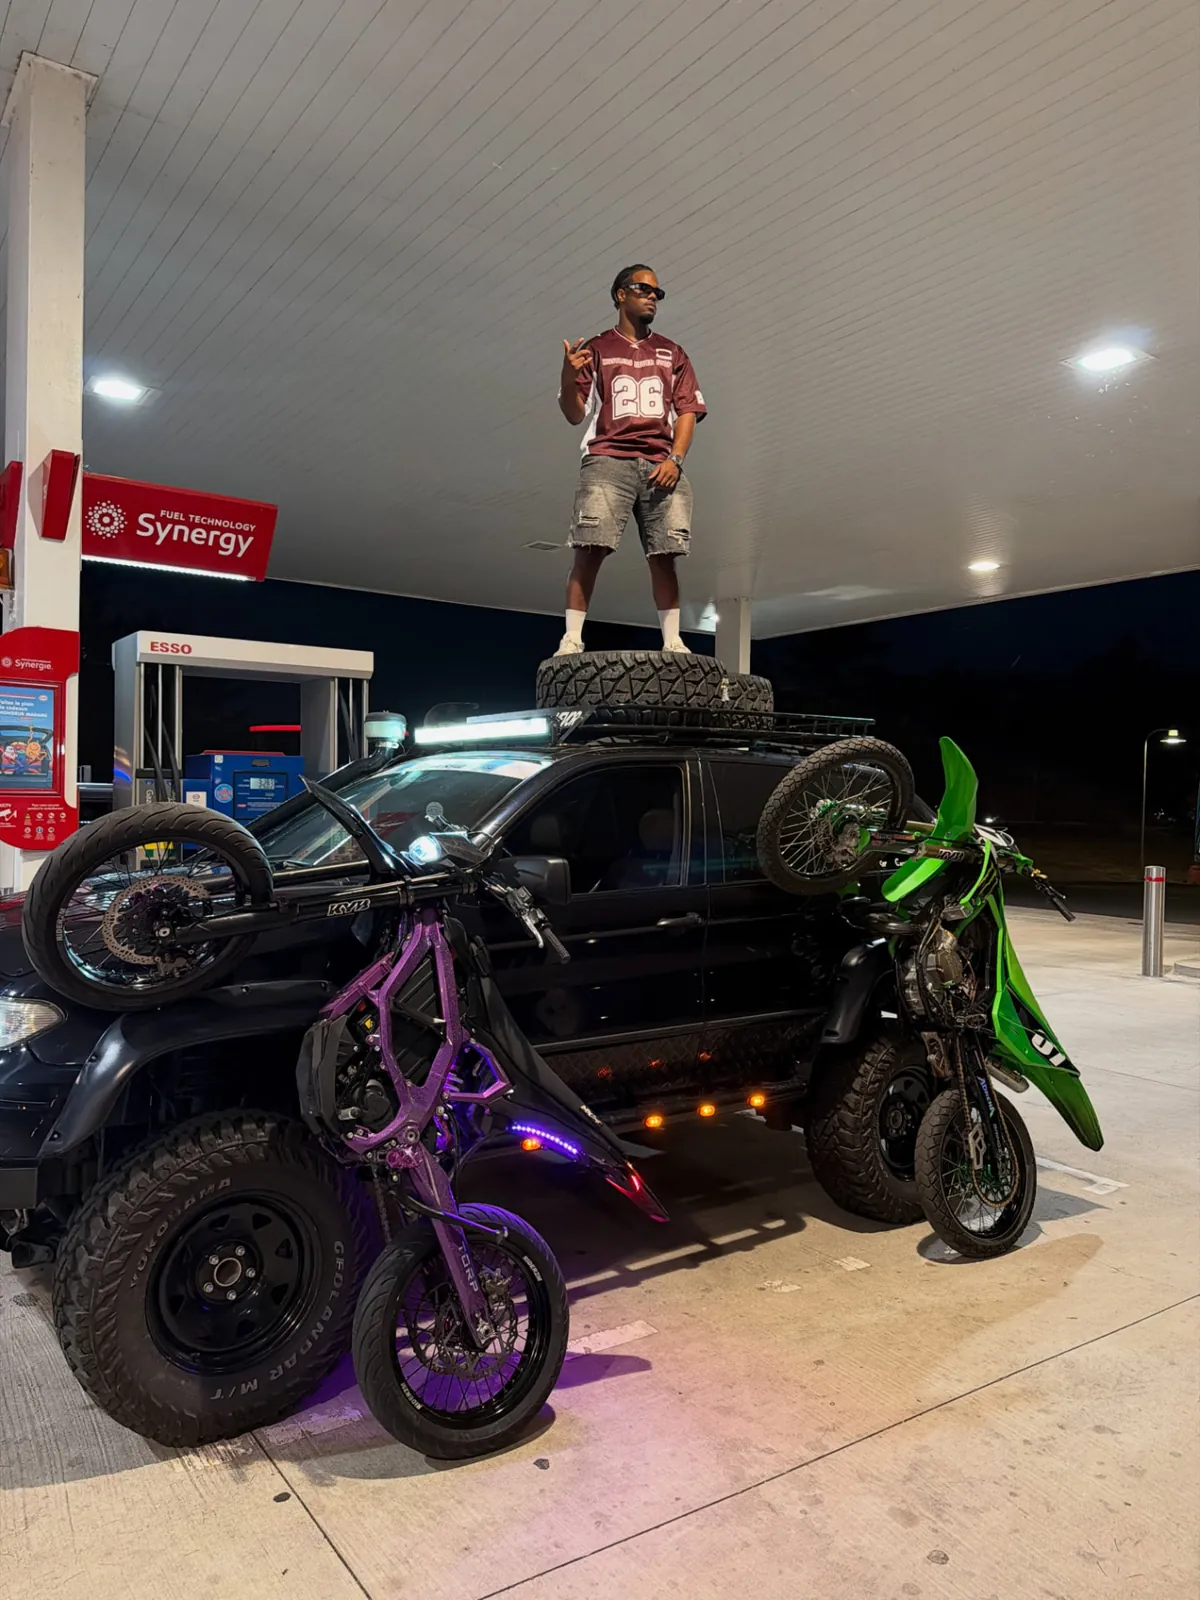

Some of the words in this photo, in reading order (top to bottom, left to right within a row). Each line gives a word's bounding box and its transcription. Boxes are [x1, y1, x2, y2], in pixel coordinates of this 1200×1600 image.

[611, 374, 665, 420] 26
[160, 509, 186, 521] FUEL
[189, 514, 256, 532] TECHNOLOGY
[136, 513, 254, 557] Synergy
[150, 641, 192, 654] ESSO
[15, 659, 52, 671] Synergie
[327, 898, 371, 917] KYB
[460, 1241, 479, 1292] TORP
